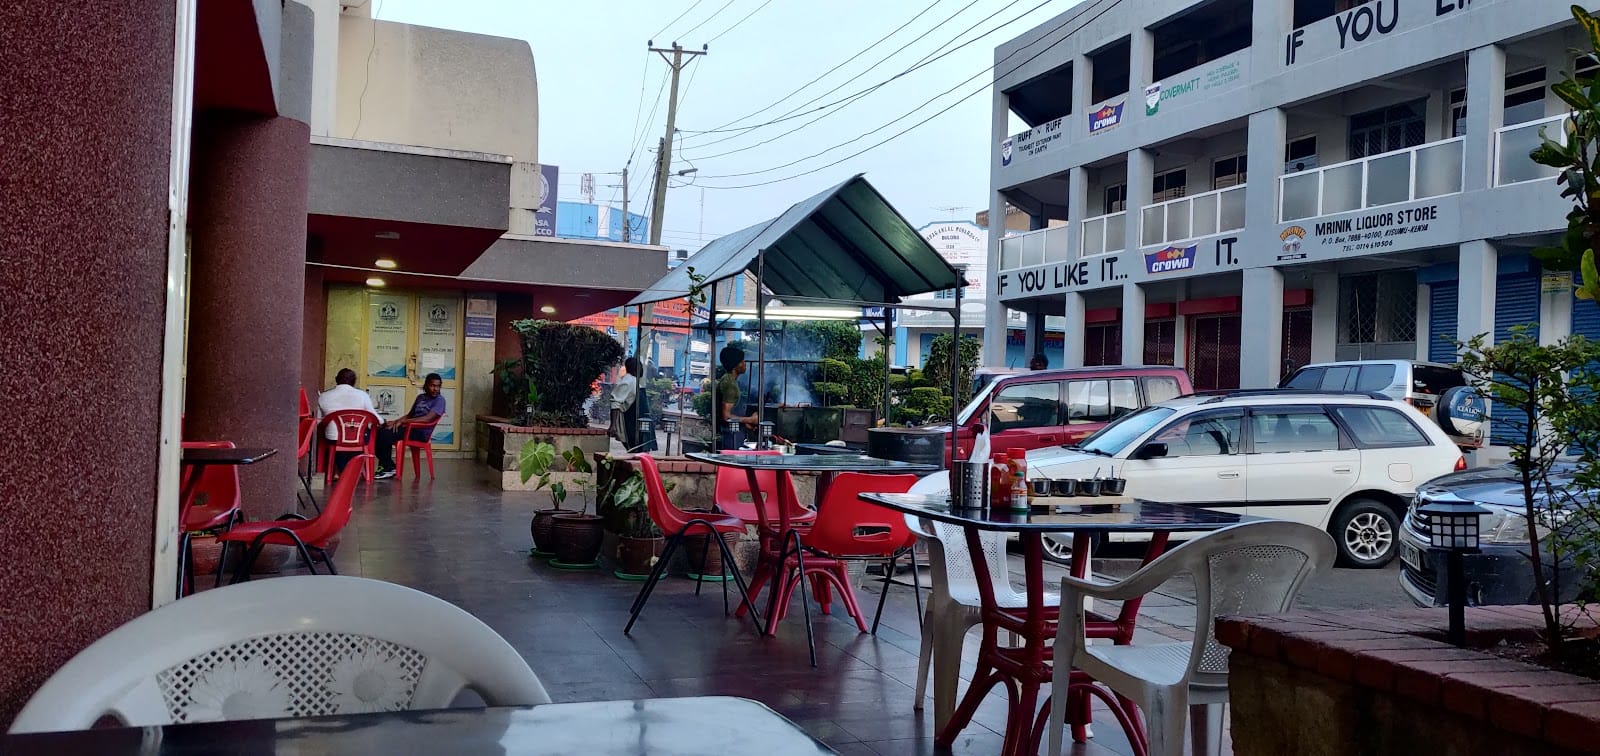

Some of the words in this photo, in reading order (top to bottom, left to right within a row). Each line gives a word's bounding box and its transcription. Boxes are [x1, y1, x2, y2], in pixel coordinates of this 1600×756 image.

[1285, 29, 1305, 66] IF
[1335, 0, 1399, 49] YOU
[1160, 77, 1201, 101] COVERMATT
[1018, 129, 1033, 143] RUFF
[1046, 119, 1062, 133] RUFF
[1315, 218, 1352, 237] MRINIK
[1356, 212, 1394, 231] LIQUOR
[1397, 205, 1438, 225] STORE
[1151, 257, 1190, 272] crown
[1215, 237, 1239, 266] IT.
[997, 274, 1008, 297] IF
[1018, 268, 1046, 293] YOU
[1054, 261, 1089, 289] LIKE
[1101, 256, 1128, 282] IT...
